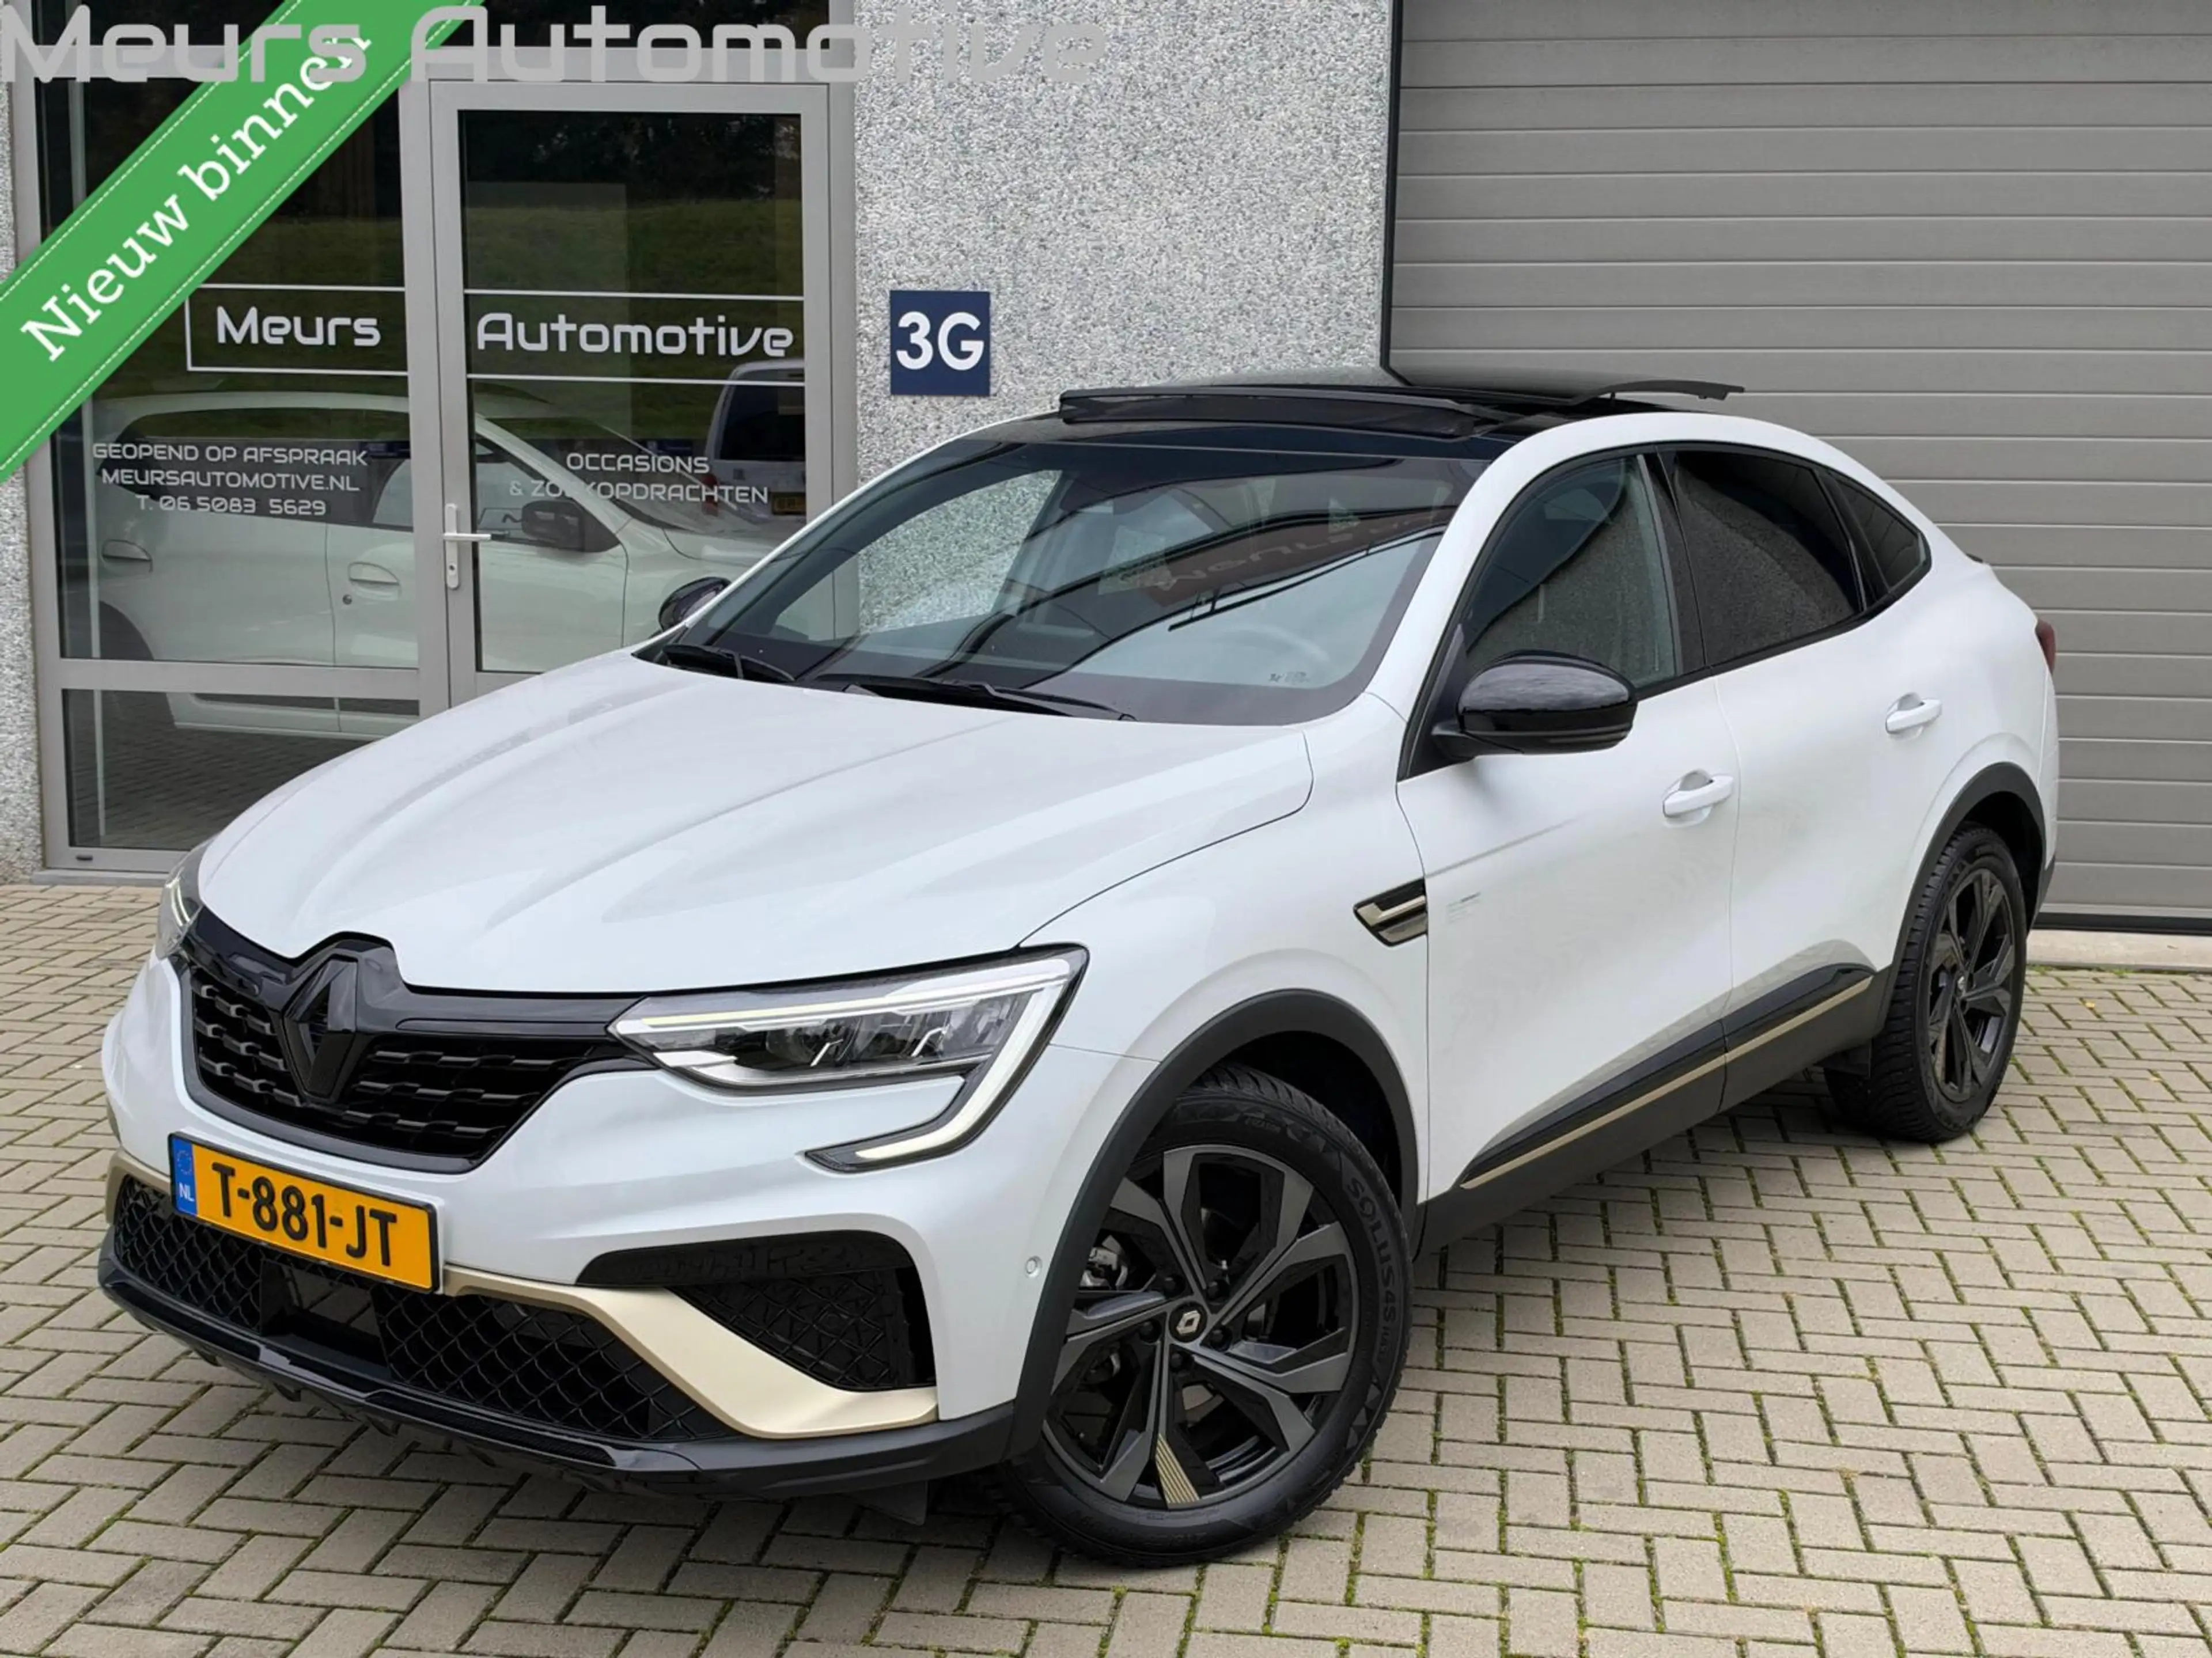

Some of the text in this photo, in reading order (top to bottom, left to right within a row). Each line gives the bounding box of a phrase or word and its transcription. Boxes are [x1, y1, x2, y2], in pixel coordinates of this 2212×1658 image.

[217, 306, 794, 356] Meurs Automotive
[896, 311, 984, 370] 3G
[93, 443, 199, 460] GEOPEND
[206, 446, 237, 461] OP
[243, 447, 368, 466] AFSPRAAK
[566, 453, 710, 473] OCCASIONS
[101, 469, 360, 491] MEURSAUTOMOTIVE.NL
[509, 480, 524, 496] &
[135, 495, 326, 516] T. 06 5083 5629
[179, 1182, 194, 1202] NL
[212, 1161, 397, 1266] T-881-JT
